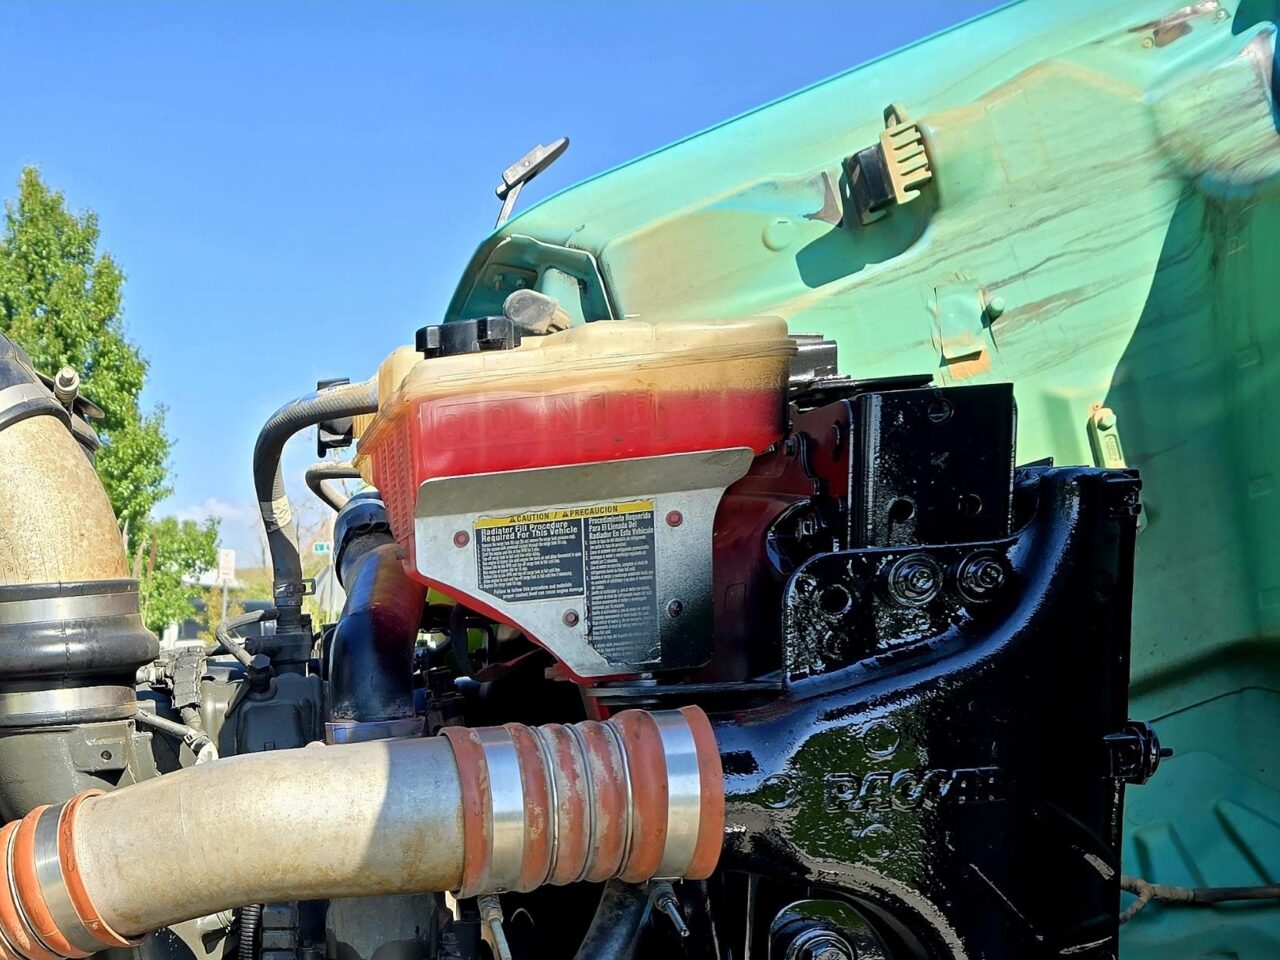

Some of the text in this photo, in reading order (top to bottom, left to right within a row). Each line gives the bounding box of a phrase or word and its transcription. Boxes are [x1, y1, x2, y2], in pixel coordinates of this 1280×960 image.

[516, 513, 550, 522] CAUTION
[569, 505, 618, 517] PRECAUCION
[481, 526, 513, 536] Radiator
[529, 521, 568, 529] Procedure
[481, 526, 578, 542] Required For This Vehicle
